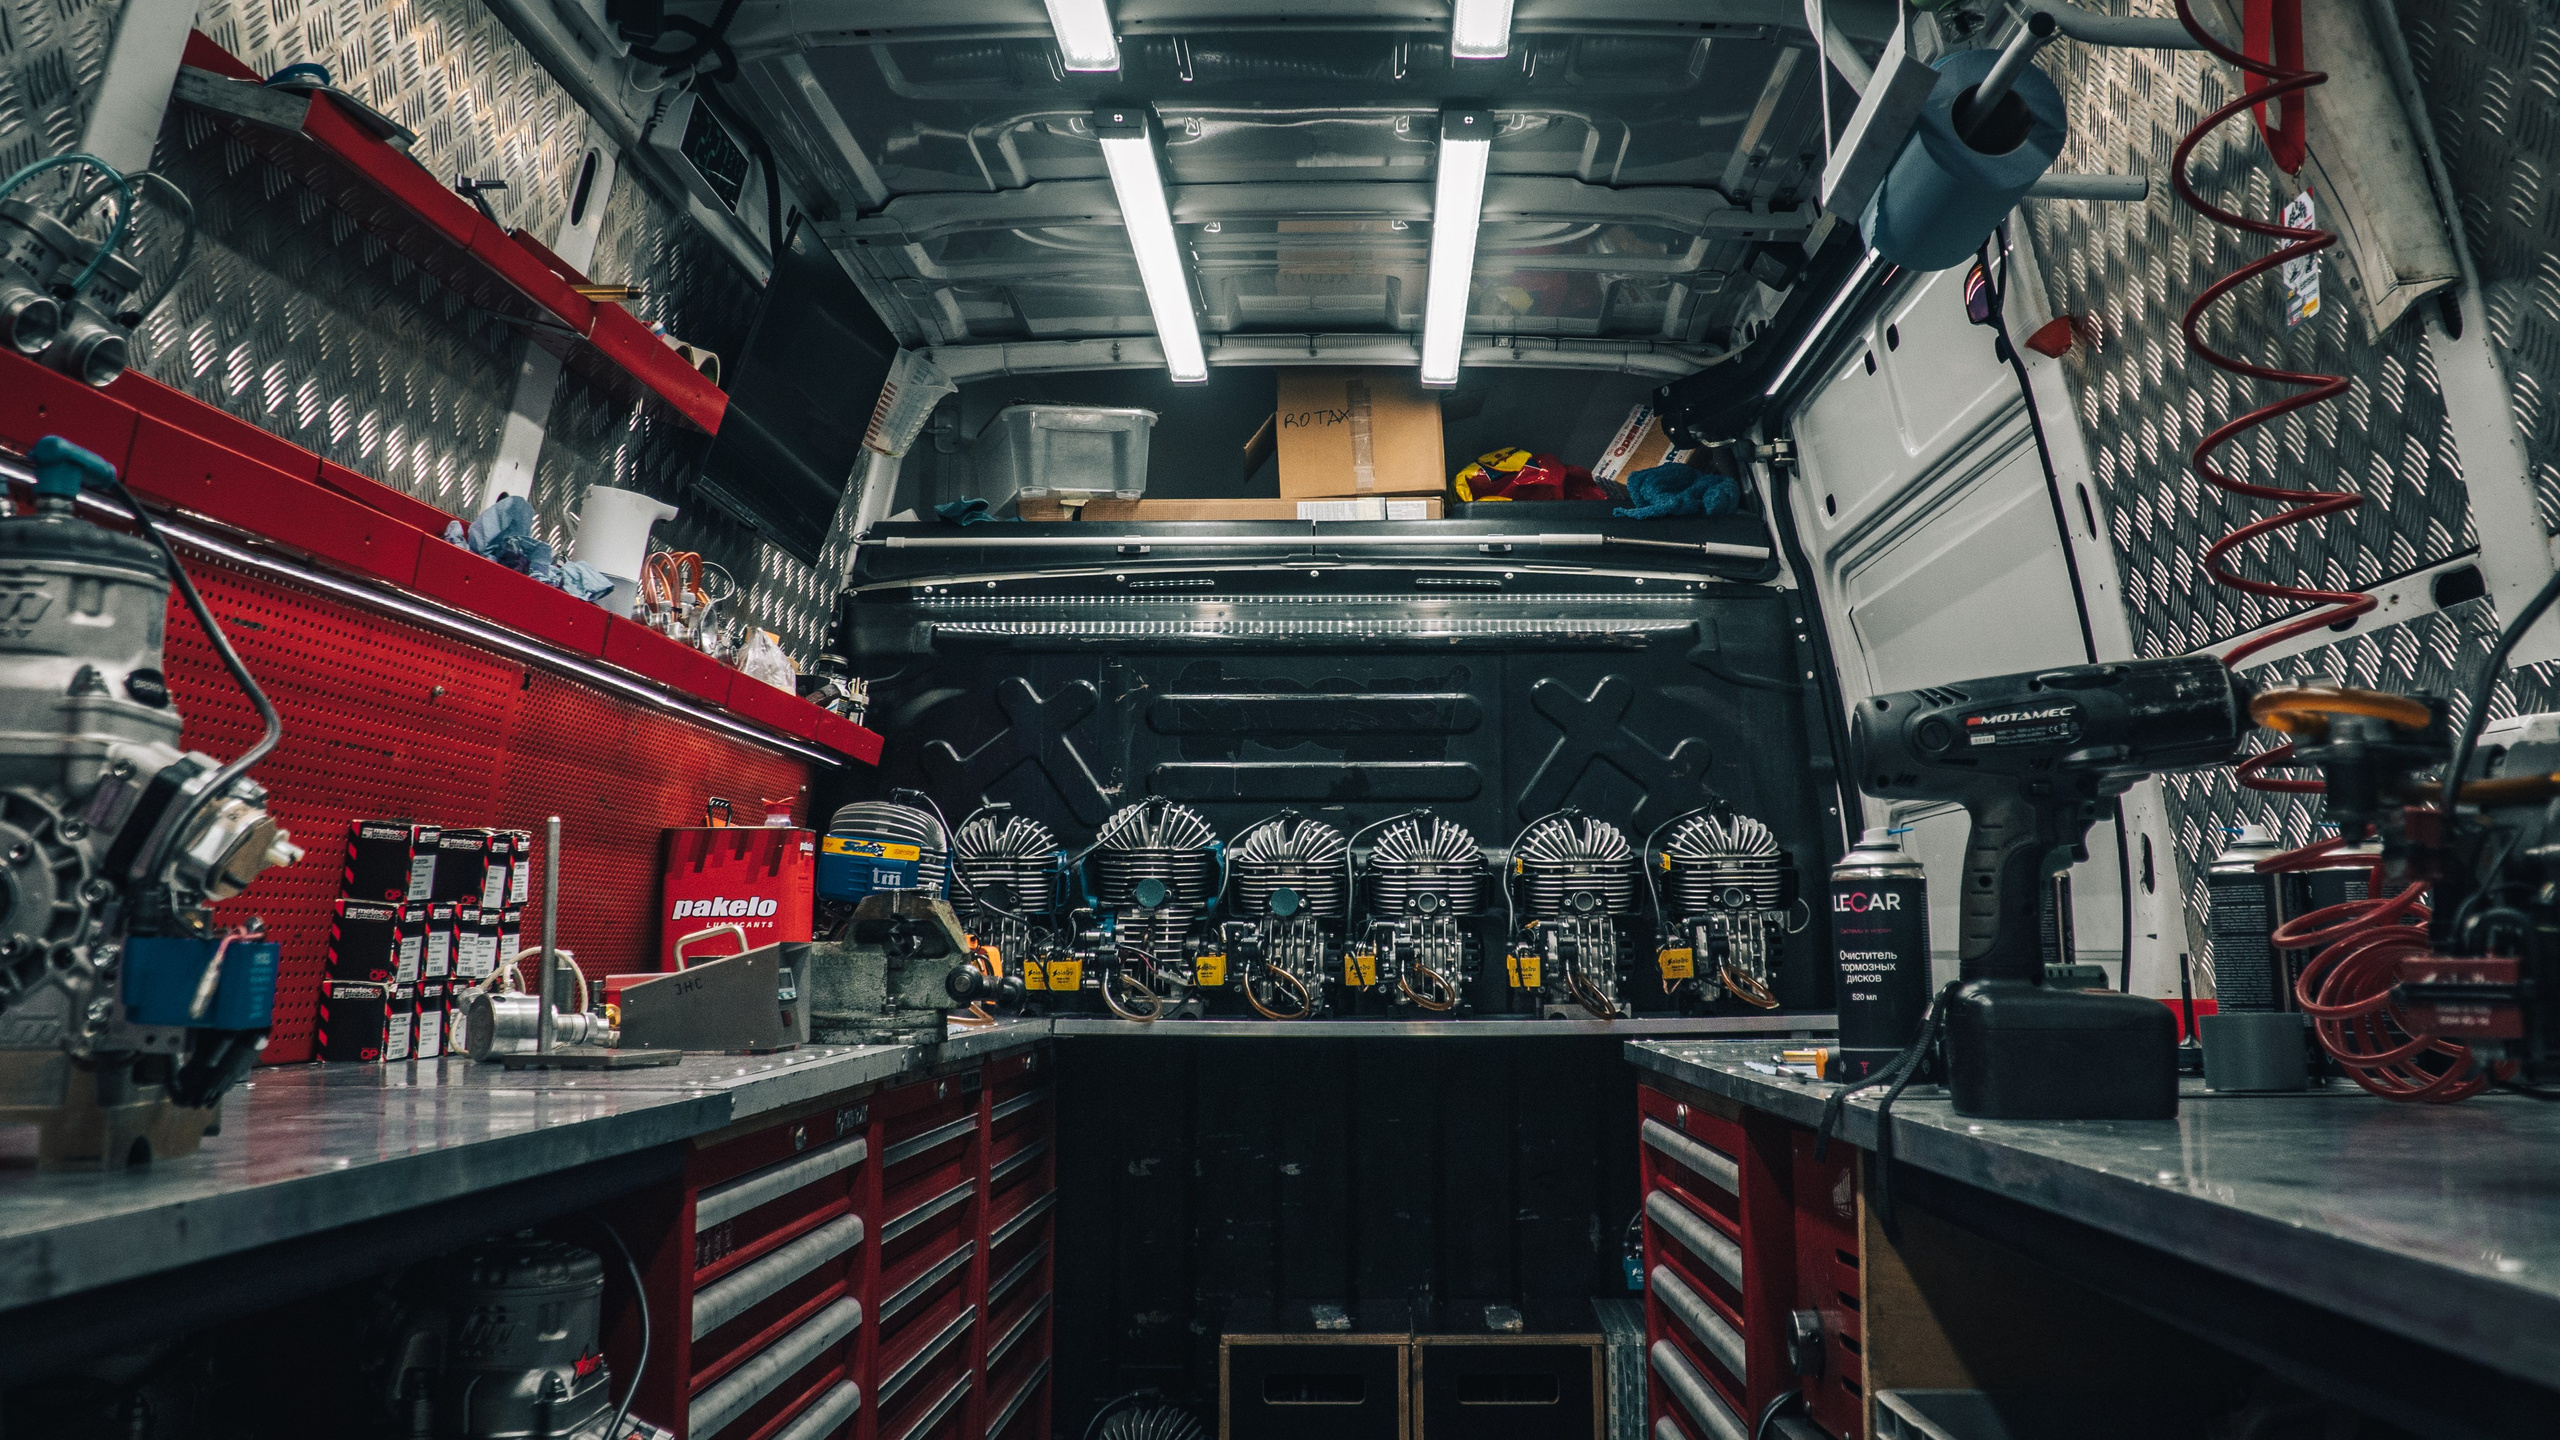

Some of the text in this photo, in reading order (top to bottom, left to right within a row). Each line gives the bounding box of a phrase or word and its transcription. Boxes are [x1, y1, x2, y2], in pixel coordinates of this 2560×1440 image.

[1284, 408, 1351, 429] ROTAX
[1980, 706, 2077, 725] MOTAMEC
[872, 867, 902, 886] tm
[671, 896, 778, 920] pakelo
[1833, 892, 1901, 913] LECAR
[1840, 950, 1898, 961] Очиститель
[1841, 963, 1896, 973] тормозных
[674, 977, 703, 996] JHC
[1846, 974, 1882, 984] дисков
[1852, 993, 1865, 1001] 520
